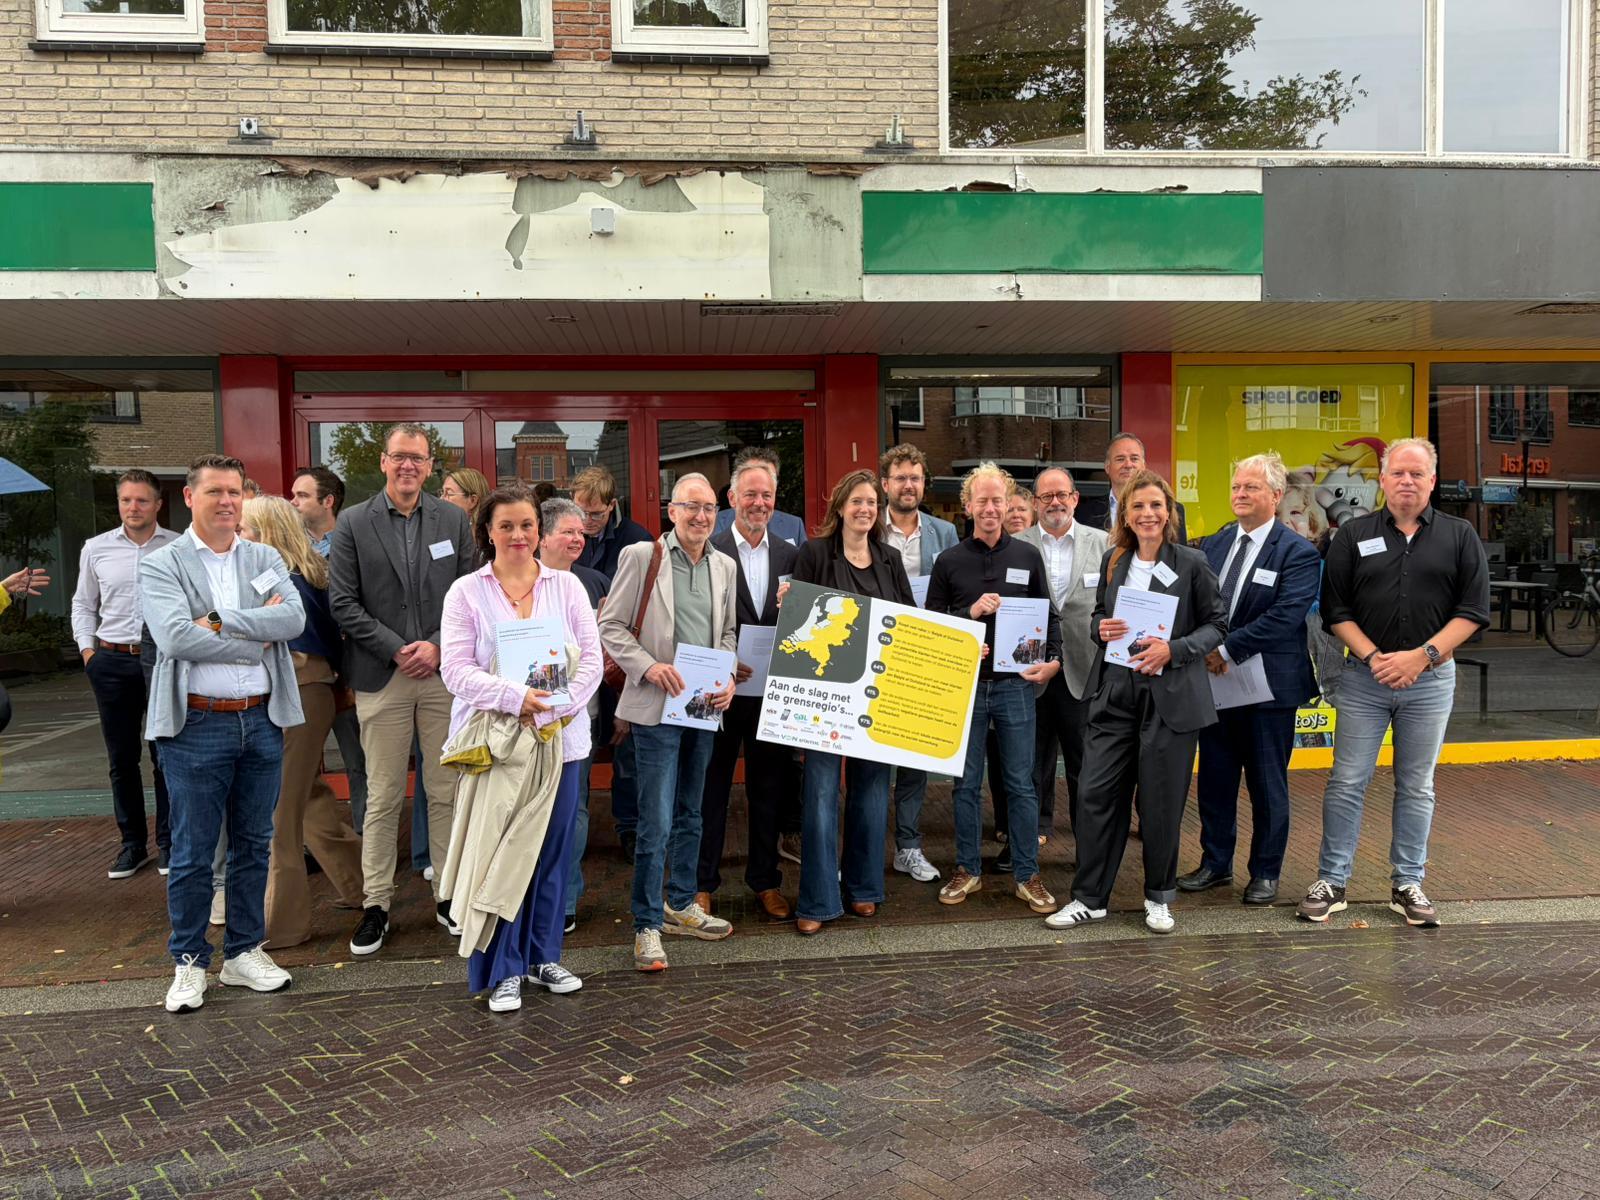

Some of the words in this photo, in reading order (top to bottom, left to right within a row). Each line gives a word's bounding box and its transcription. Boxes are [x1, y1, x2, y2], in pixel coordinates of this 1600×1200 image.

[767, 690, 780, 701] de
[783, 695, 854, 716] grensregio's...
[769, 679, 790, 691] Aan
[792, 683, 806, 694] de
[808, 687, 829, 700] slag
[831, 693, 851, 703] met
